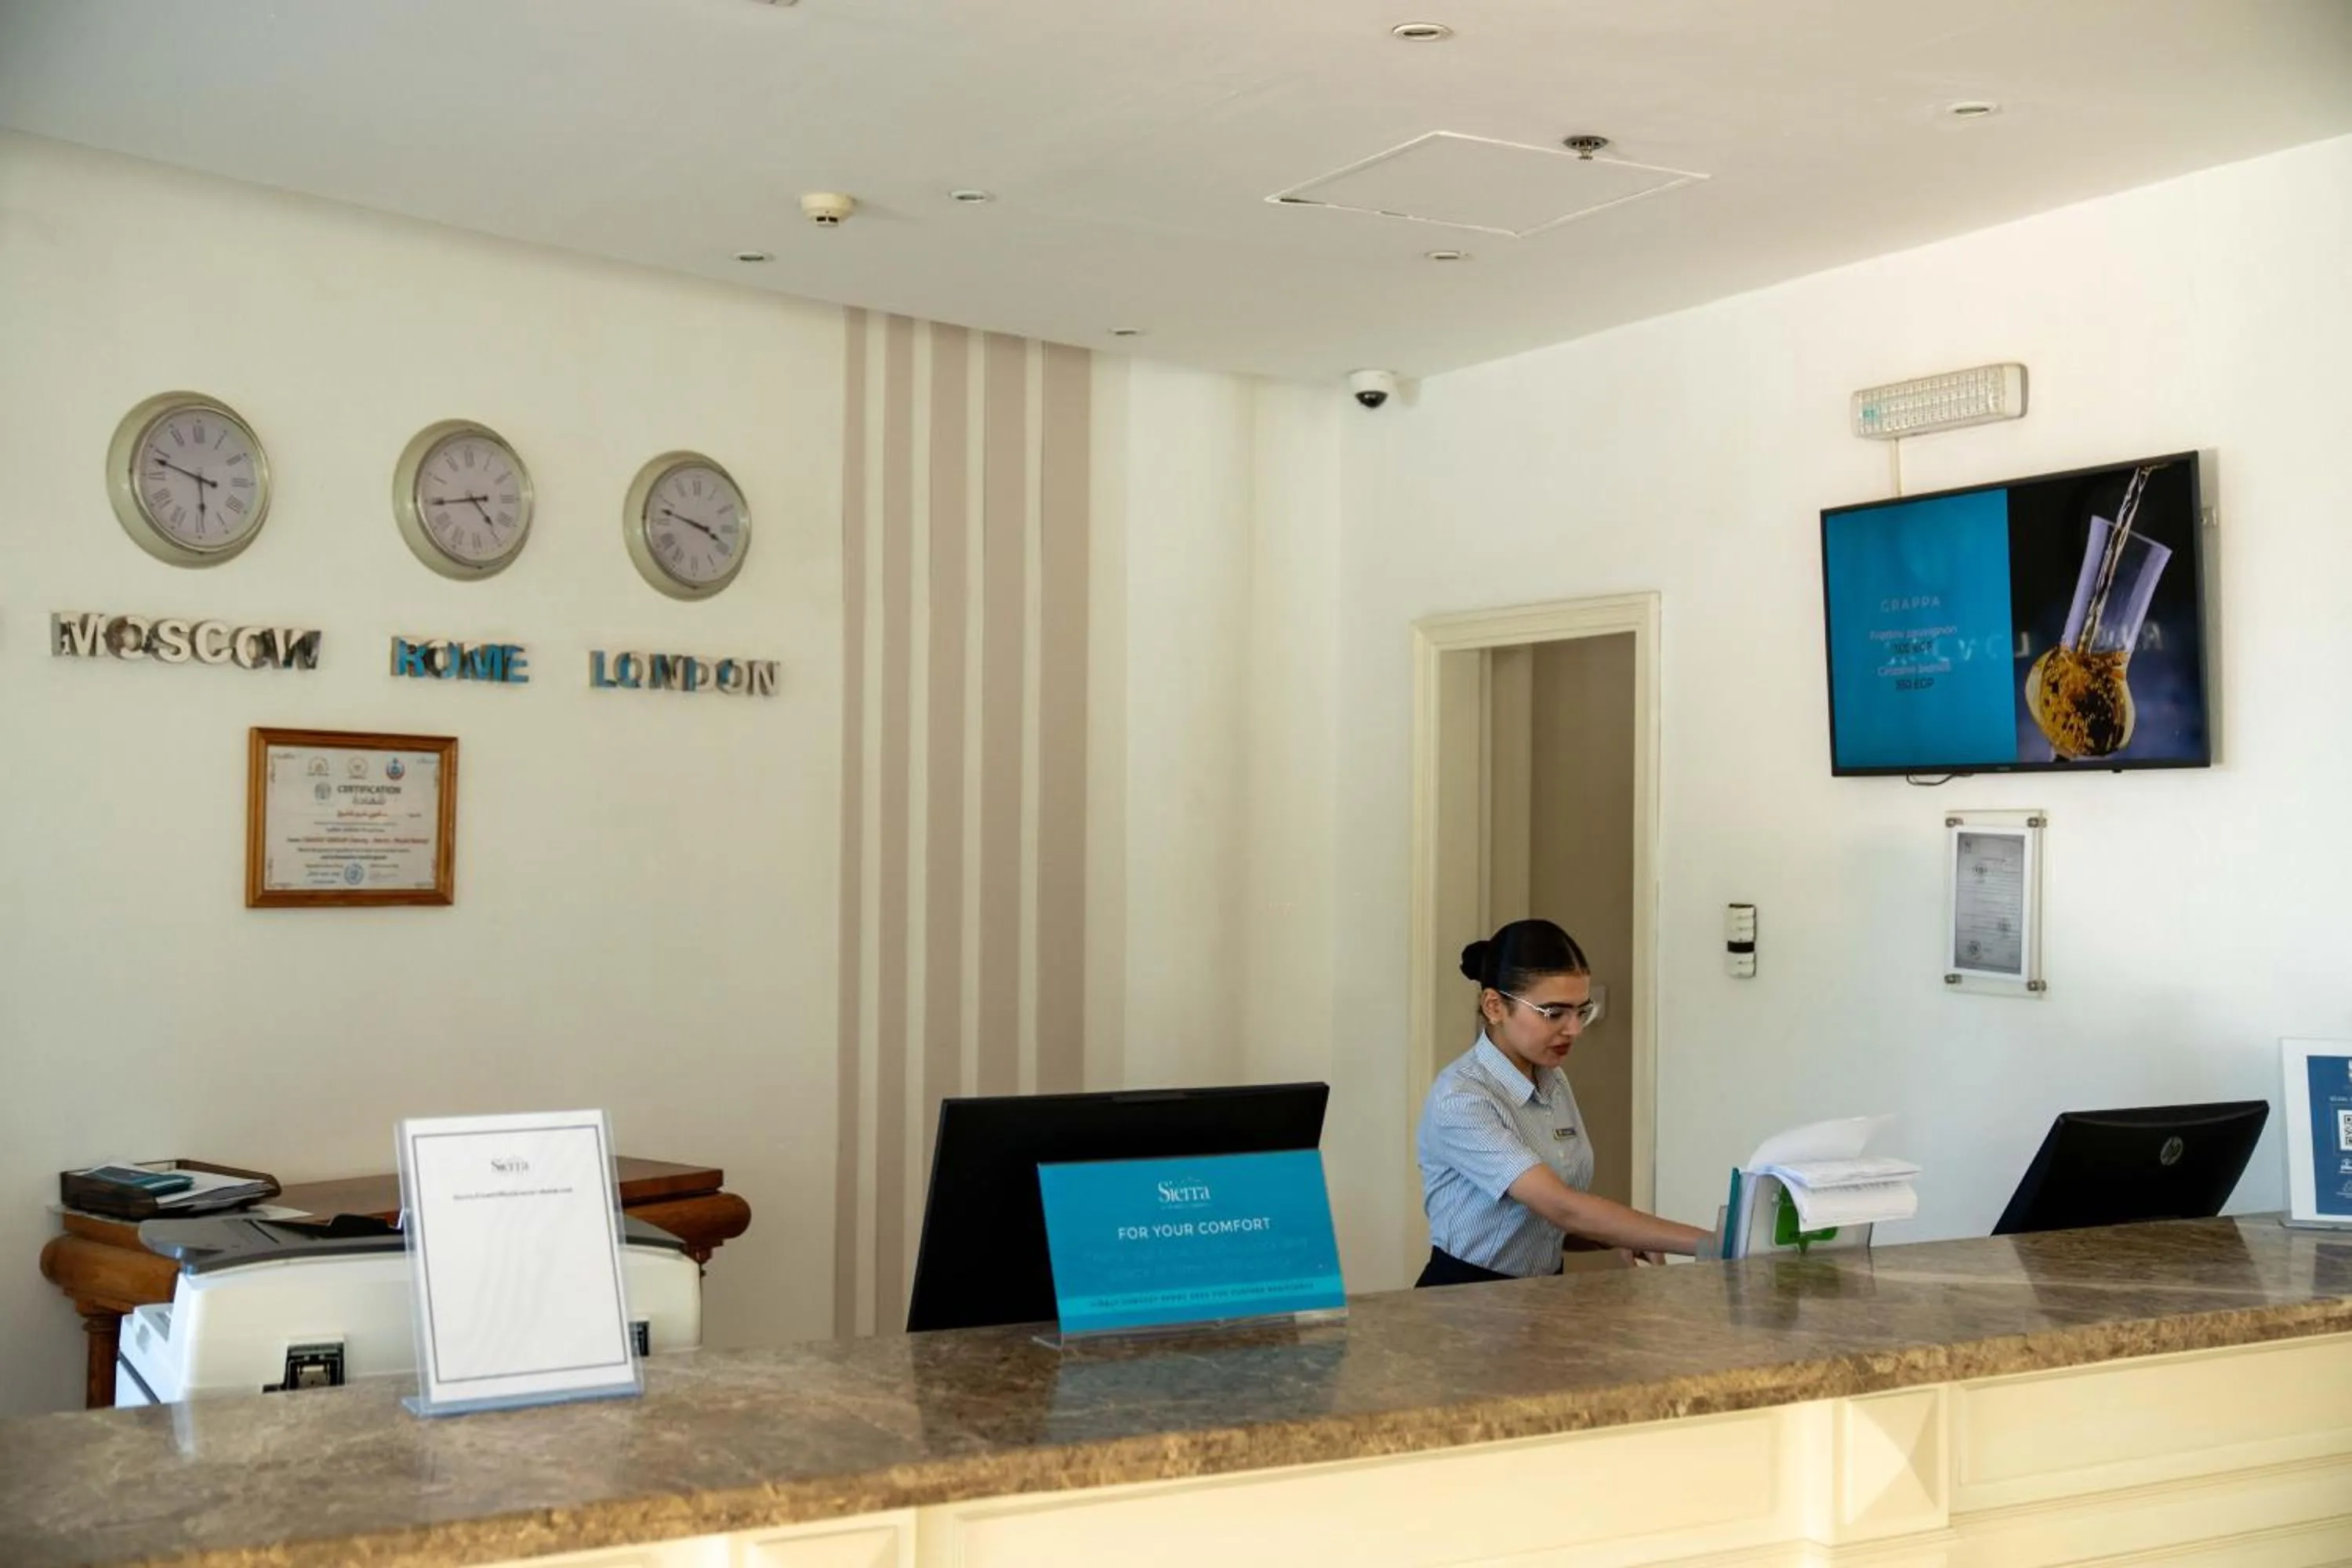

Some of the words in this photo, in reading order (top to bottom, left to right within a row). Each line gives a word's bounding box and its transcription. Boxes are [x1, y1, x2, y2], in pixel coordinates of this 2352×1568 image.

[1882, 596, 1941, 612] GRAPPA
[51, 612, 322, 670] MOSCOW
[391, 636, 530, 683] ROME
[590, 650, 780, 695] LONDON
[336, 785, 402, 795] CERTIFICATION
[1157, 1179, 1211, 1203] Sierra
[1118, 1226, 1149, 1240] FOR
[1152, 1221, 1194, 1238] YOUR
[1198, 1217, 1271, 1236] COMFORT
